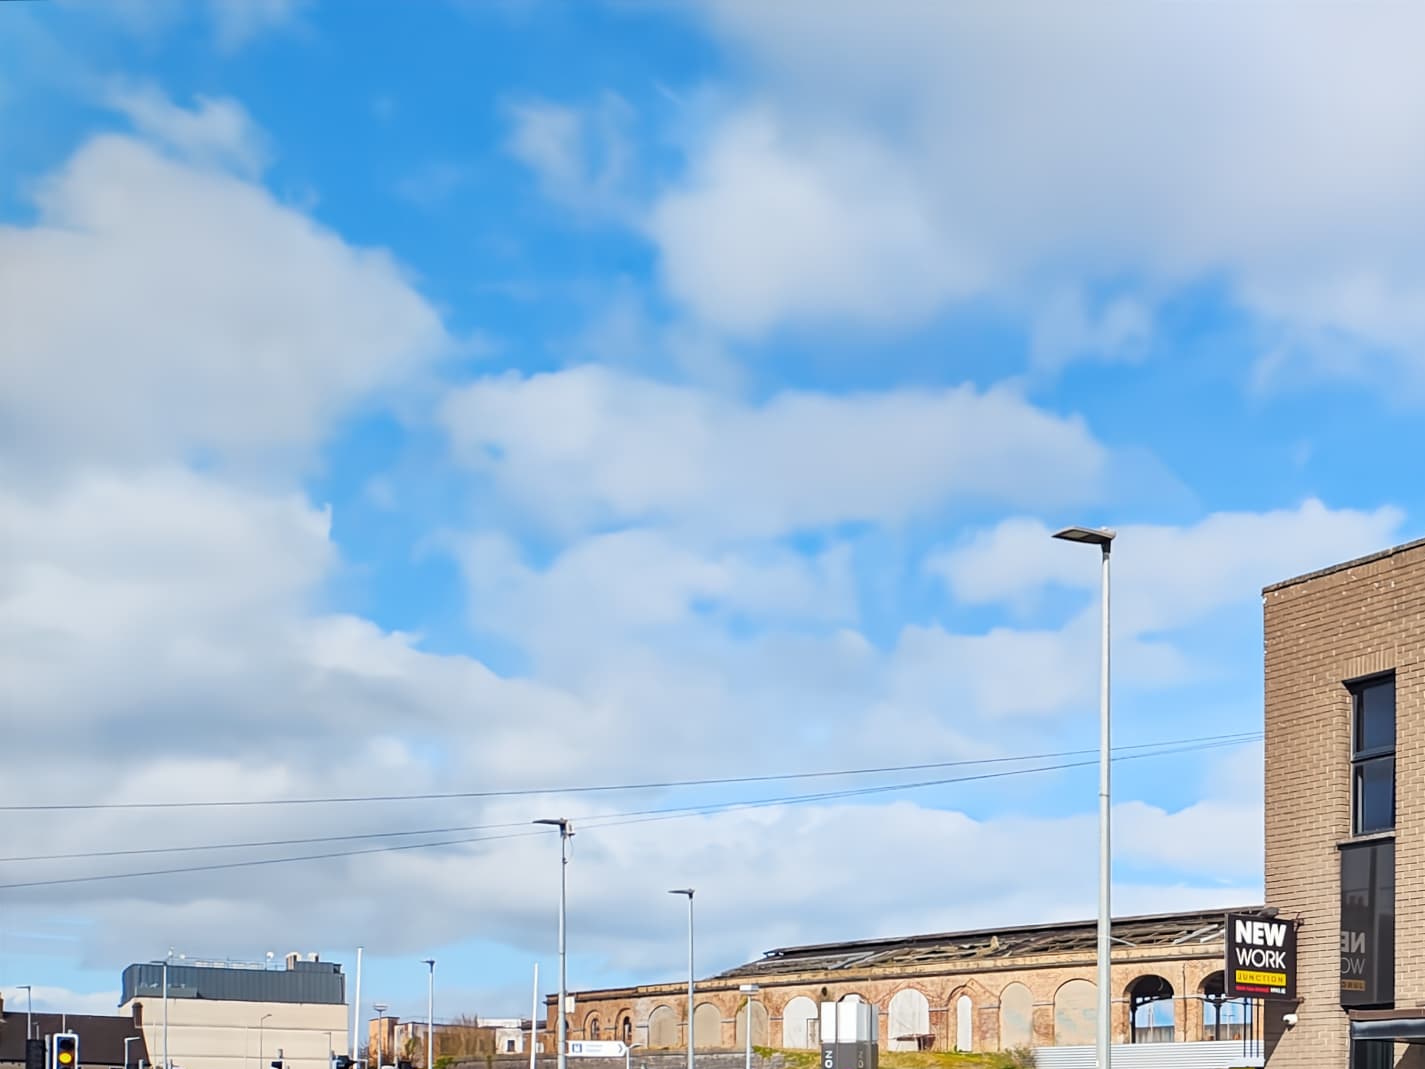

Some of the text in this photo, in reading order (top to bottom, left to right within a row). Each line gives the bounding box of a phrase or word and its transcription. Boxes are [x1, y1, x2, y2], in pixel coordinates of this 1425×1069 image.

[1235, 919, 1287, 947] NEW
[1235, 947, 1286, 969] WORK
[1237, 972, 1284, 984] JUNCTION
